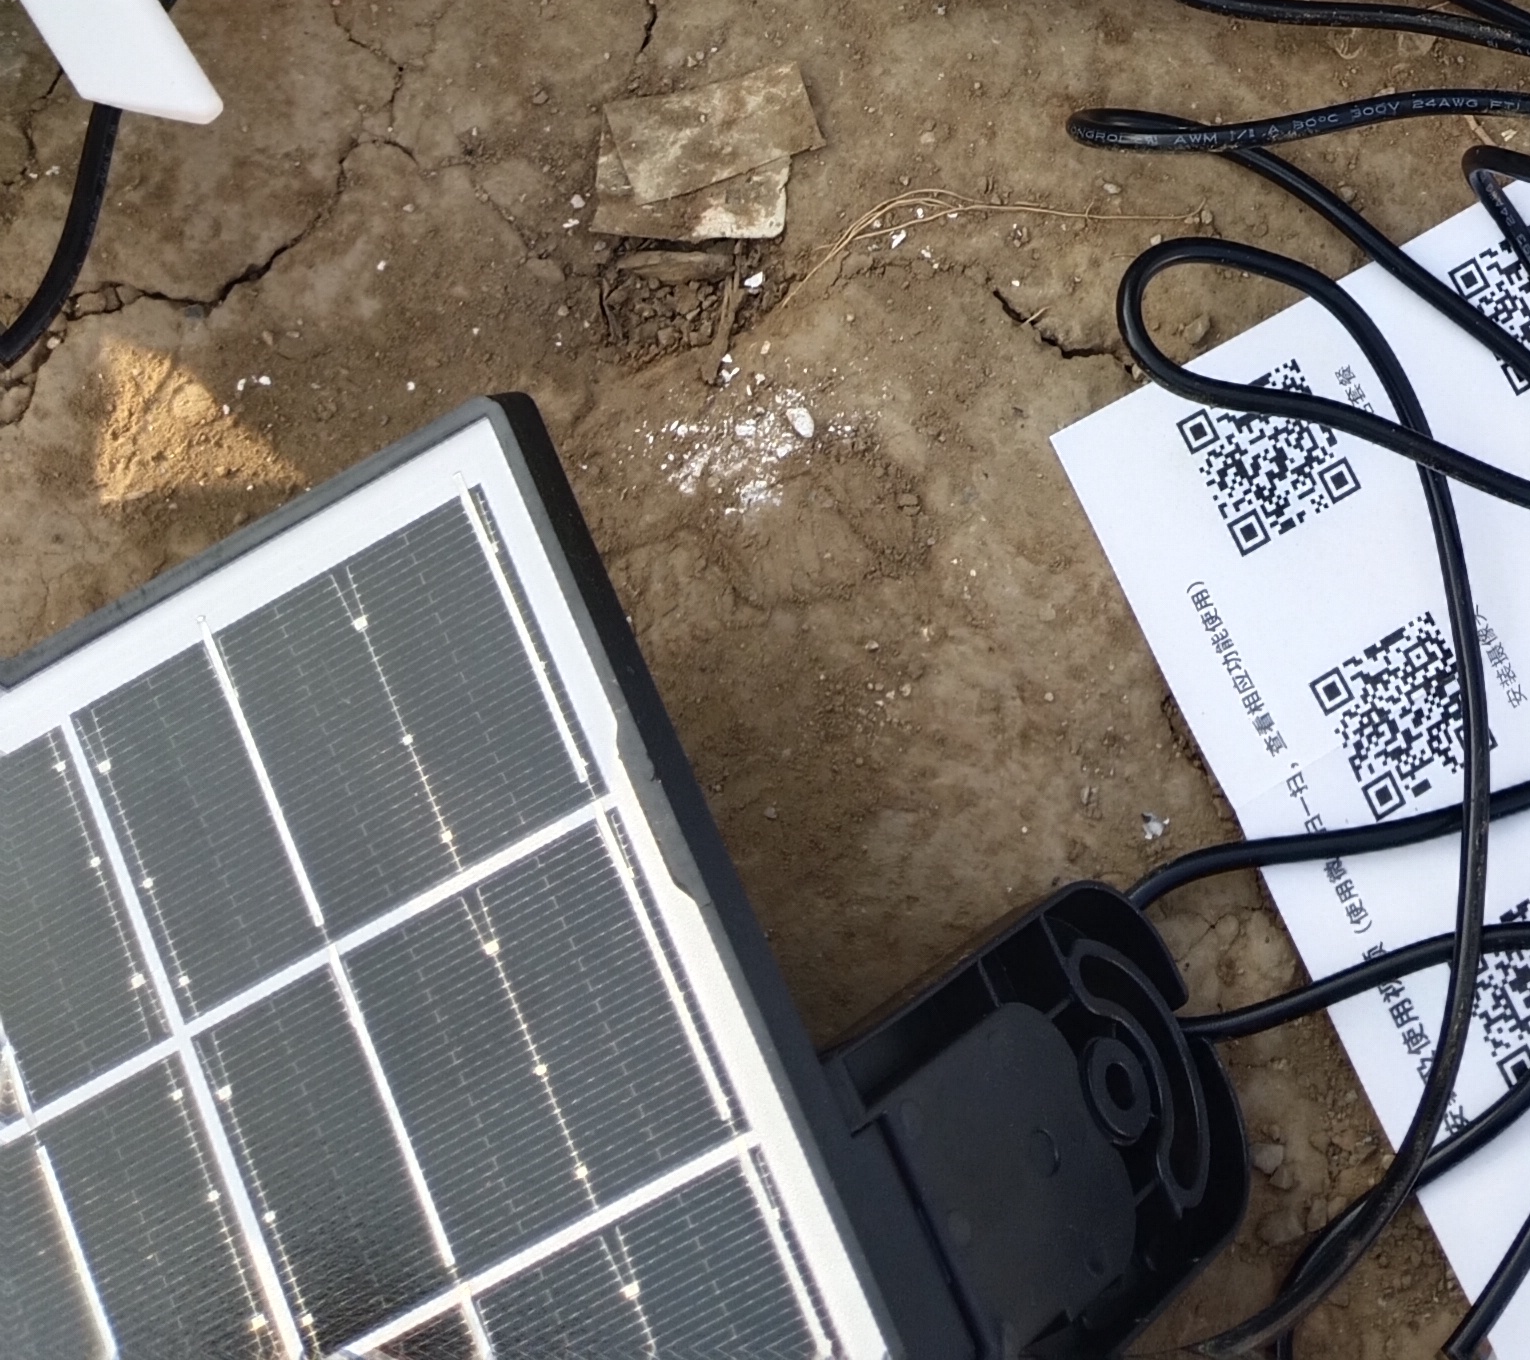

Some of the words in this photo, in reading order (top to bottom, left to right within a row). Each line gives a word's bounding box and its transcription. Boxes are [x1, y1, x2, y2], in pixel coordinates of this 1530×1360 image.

[1173, 131, 1218, 145] AWM
[1350, 100, 1401, 119] 300V
[1411, 97, 1479, 110] 24AWG
